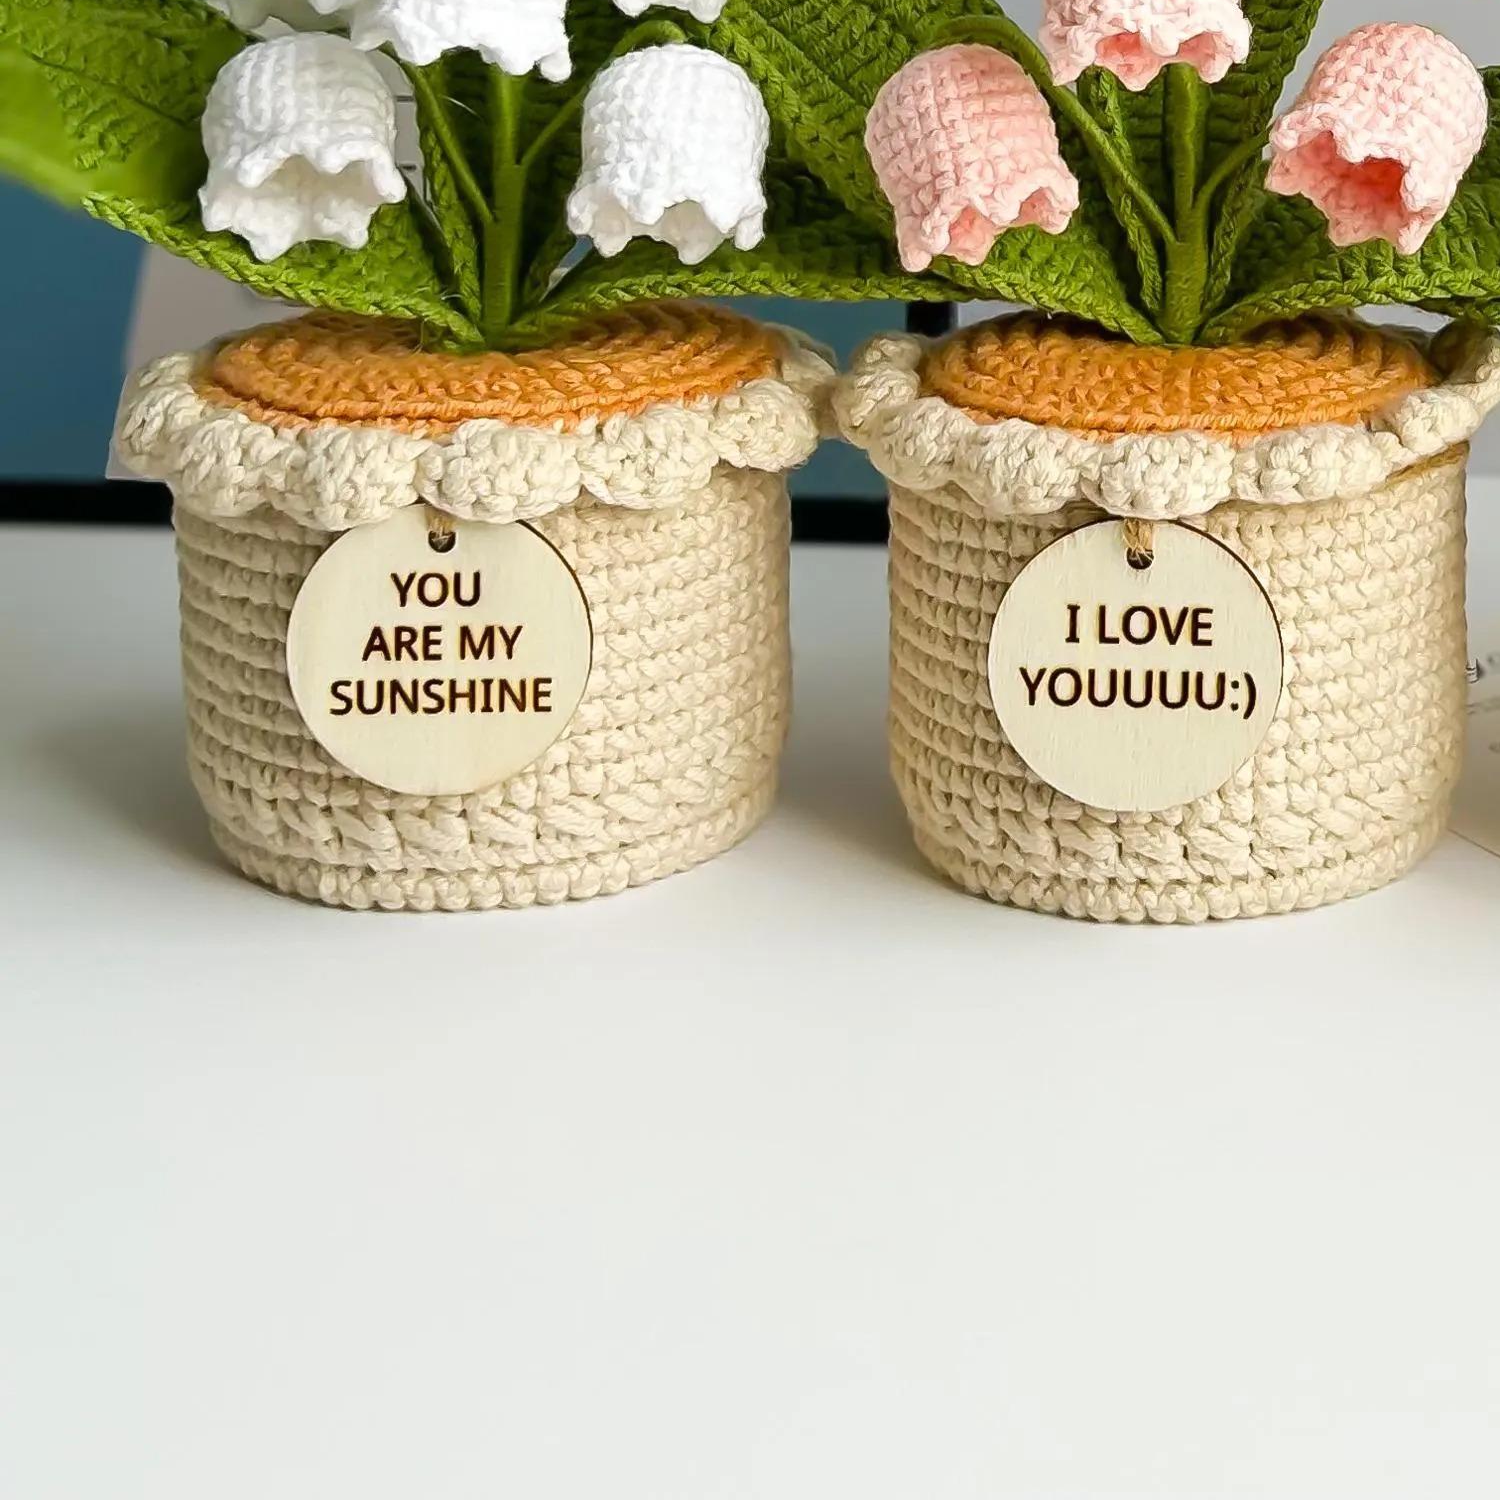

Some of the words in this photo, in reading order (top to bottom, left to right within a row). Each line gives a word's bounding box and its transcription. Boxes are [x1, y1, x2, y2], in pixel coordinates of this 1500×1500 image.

[390, 570, 481, 608] YOU
[361, 625, 443, 662] ARE
[459, 624, 523, 661] MY
[1064, 603, 1081, 644] I
[1097, 604, 1214, 647] LOVE
[329, 677, 553, 716] SUNSHINE
[1018, 666, 1257, 720] YOUUUU:)
